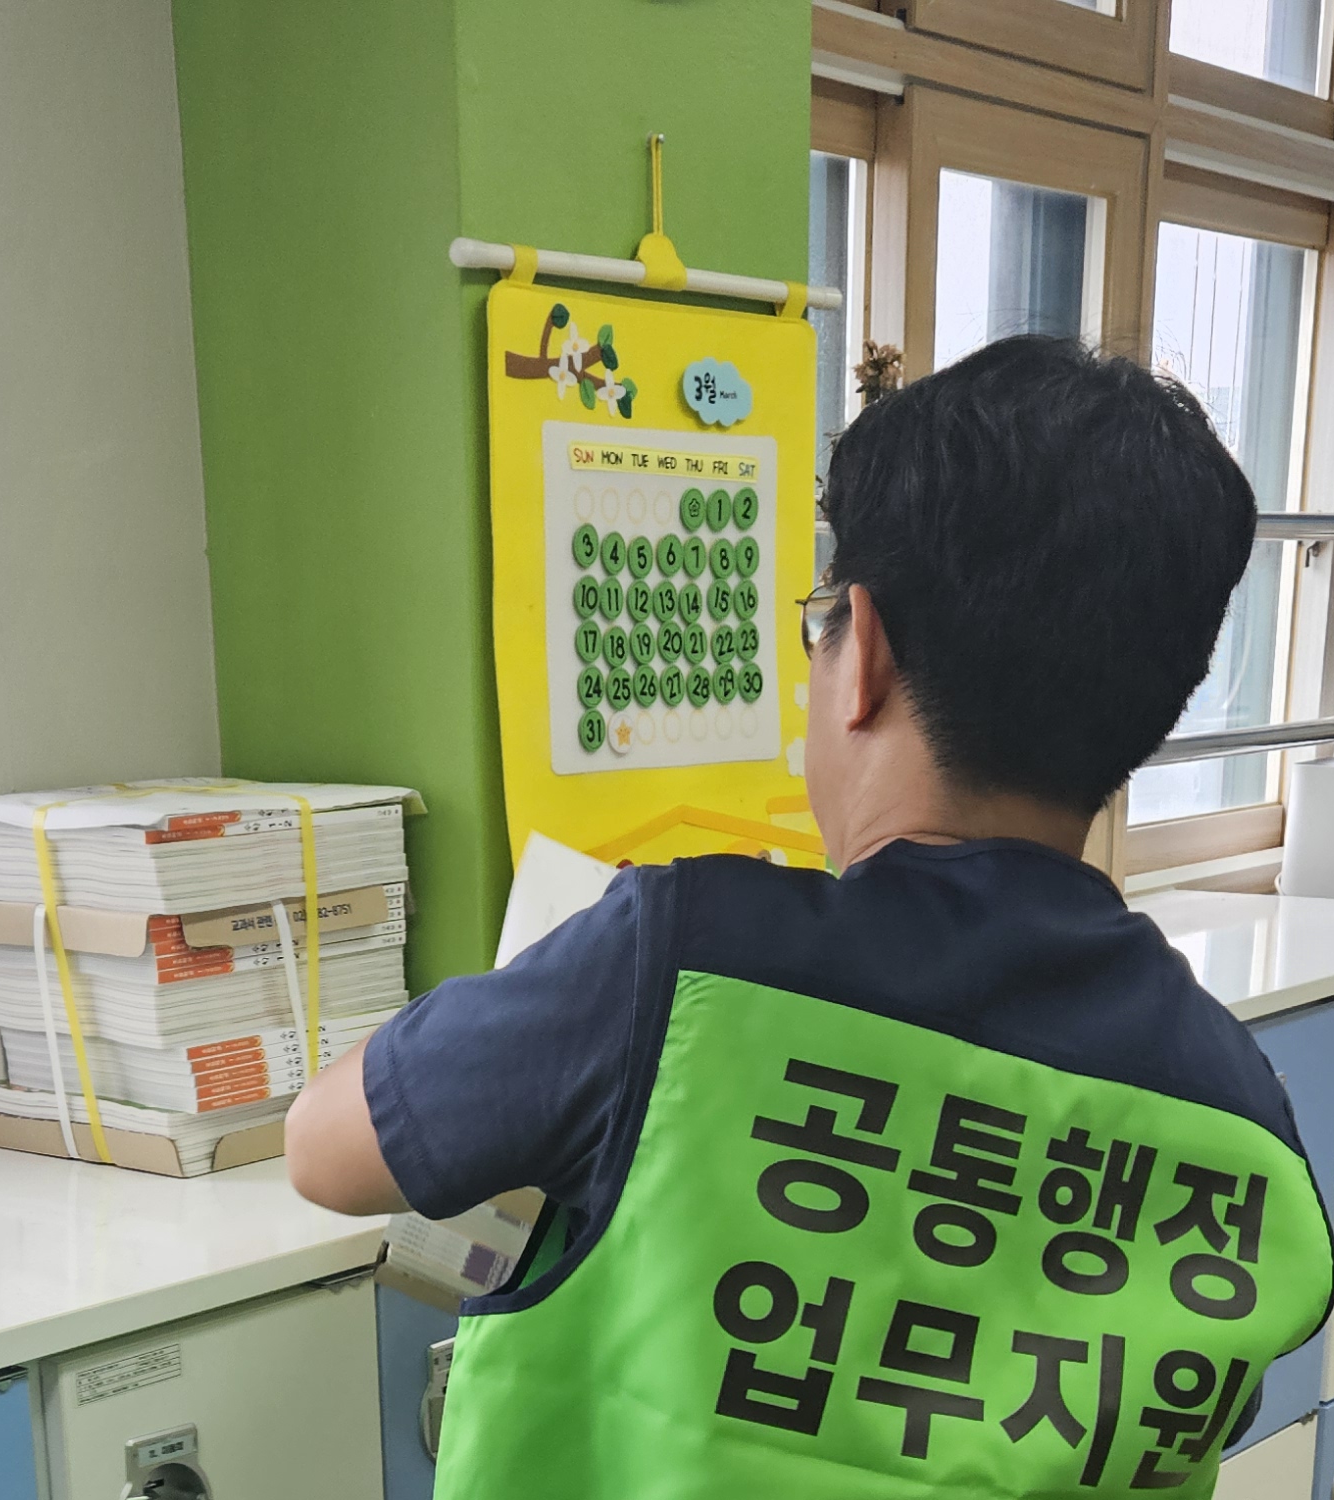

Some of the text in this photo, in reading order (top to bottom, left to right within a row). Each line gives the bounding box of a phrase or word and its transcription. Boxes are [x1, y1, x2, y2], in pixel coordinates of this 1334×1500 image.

[693, 372, 716, 404] 3월
[573, 447, 756, 477] SUN MON TUE WED THU FRI SAT
[741, 496, 752, 520] 2
[582, 533, 754, 571] 3 4 5 6 7 8 9
[580, 584, 756, 615] 10 11 12 13 14 15 16
[583, 628, 758, 659] 17 18 19 20 21 22 23
[584, 668, 763, 701] 24 25 26 27 28 29 30
[586, 718, 602, 743] 31
[750, 1058, 1268, 1321] 공통행정
[712, 1260, 1250, 1490] 업무지원
